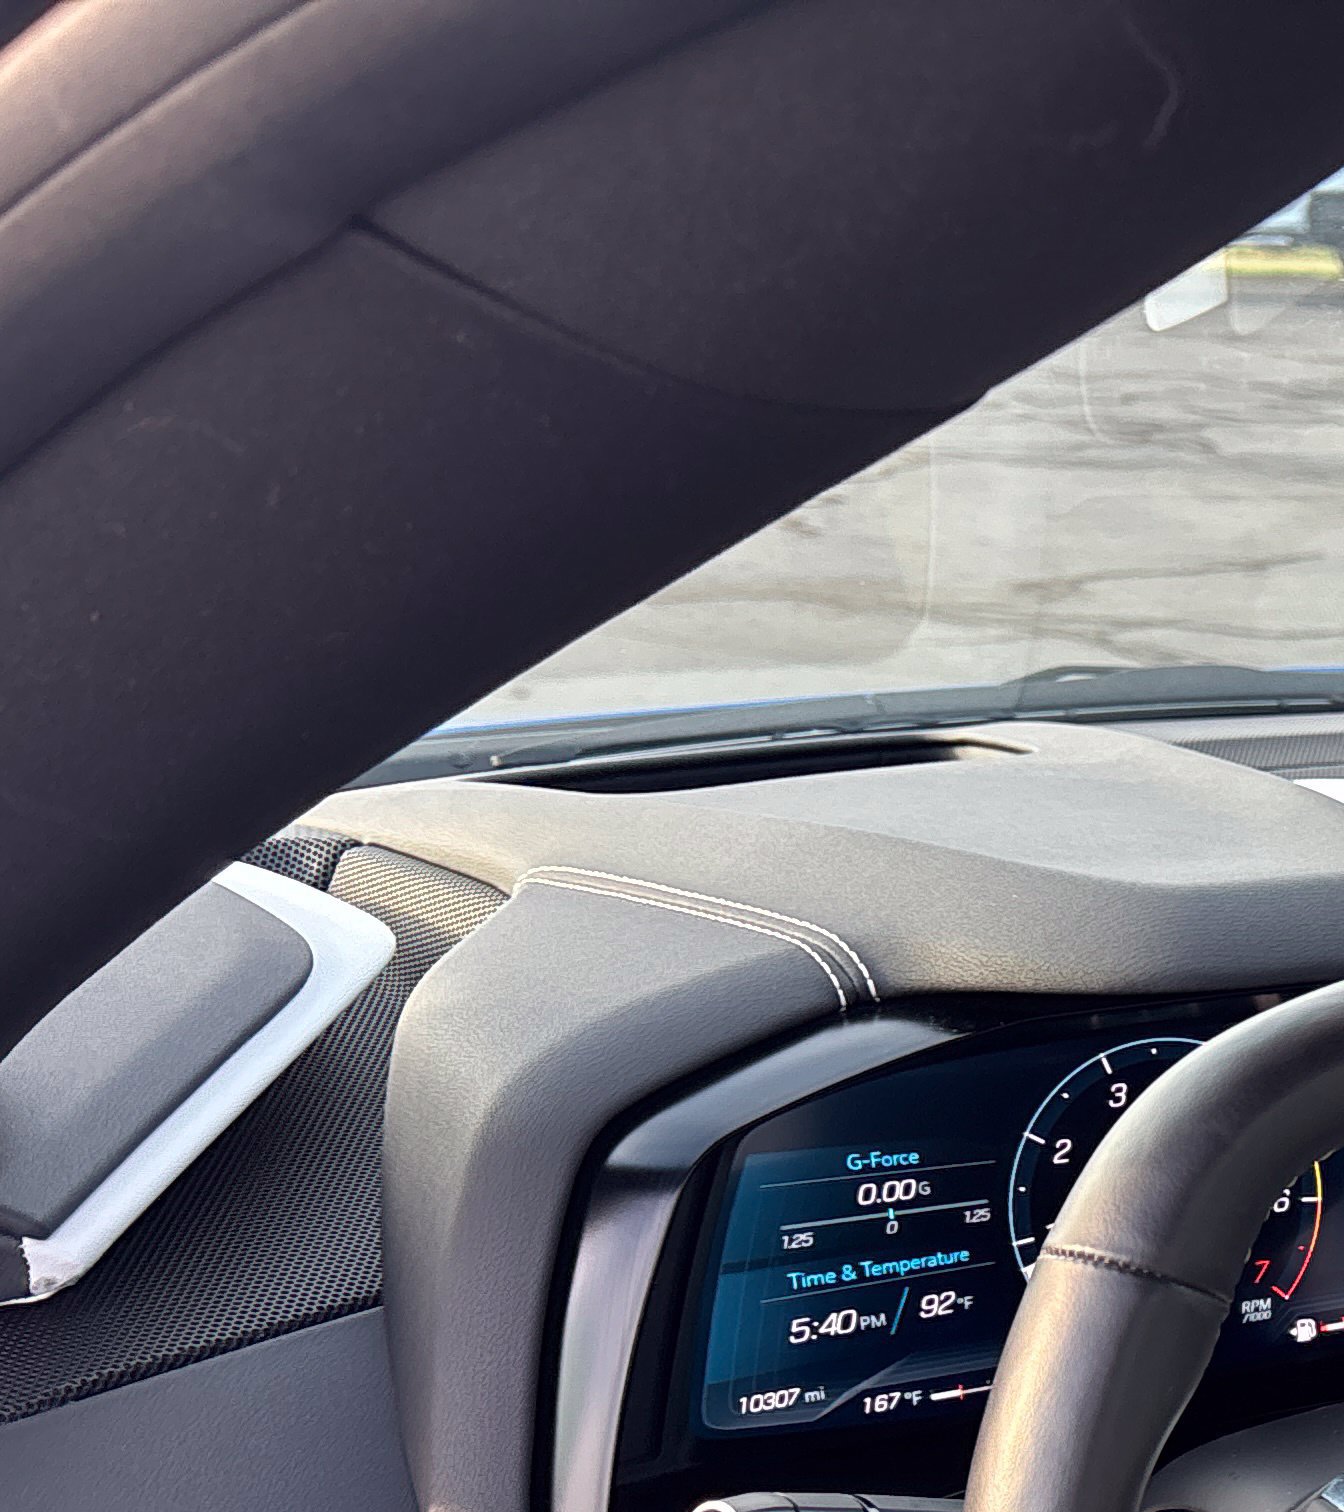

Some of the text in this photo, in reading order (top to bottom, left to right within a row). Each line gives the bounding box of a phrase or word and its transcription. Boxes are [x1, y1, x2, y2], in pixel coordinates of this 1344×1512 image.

[1108, 1082, 1129, 1109] 3
[847, 1149, 920, 1171] G-Force
[1053, 1139, 1073, 1166] 2
[886, 1220, 898, 1236] 0
[781, 1231, 815, 1251] 1.25
[788, 1247, 970, 1291] Time & Temperature
[1254, 1261, 1271, 1284] 7
[1241, 1298, 1272, 1315] RPM
[739, 1389, 801, 1415] 10307
[805, 1386, 826, 1404] mi
[862, 1390, 903, 1416] 167
